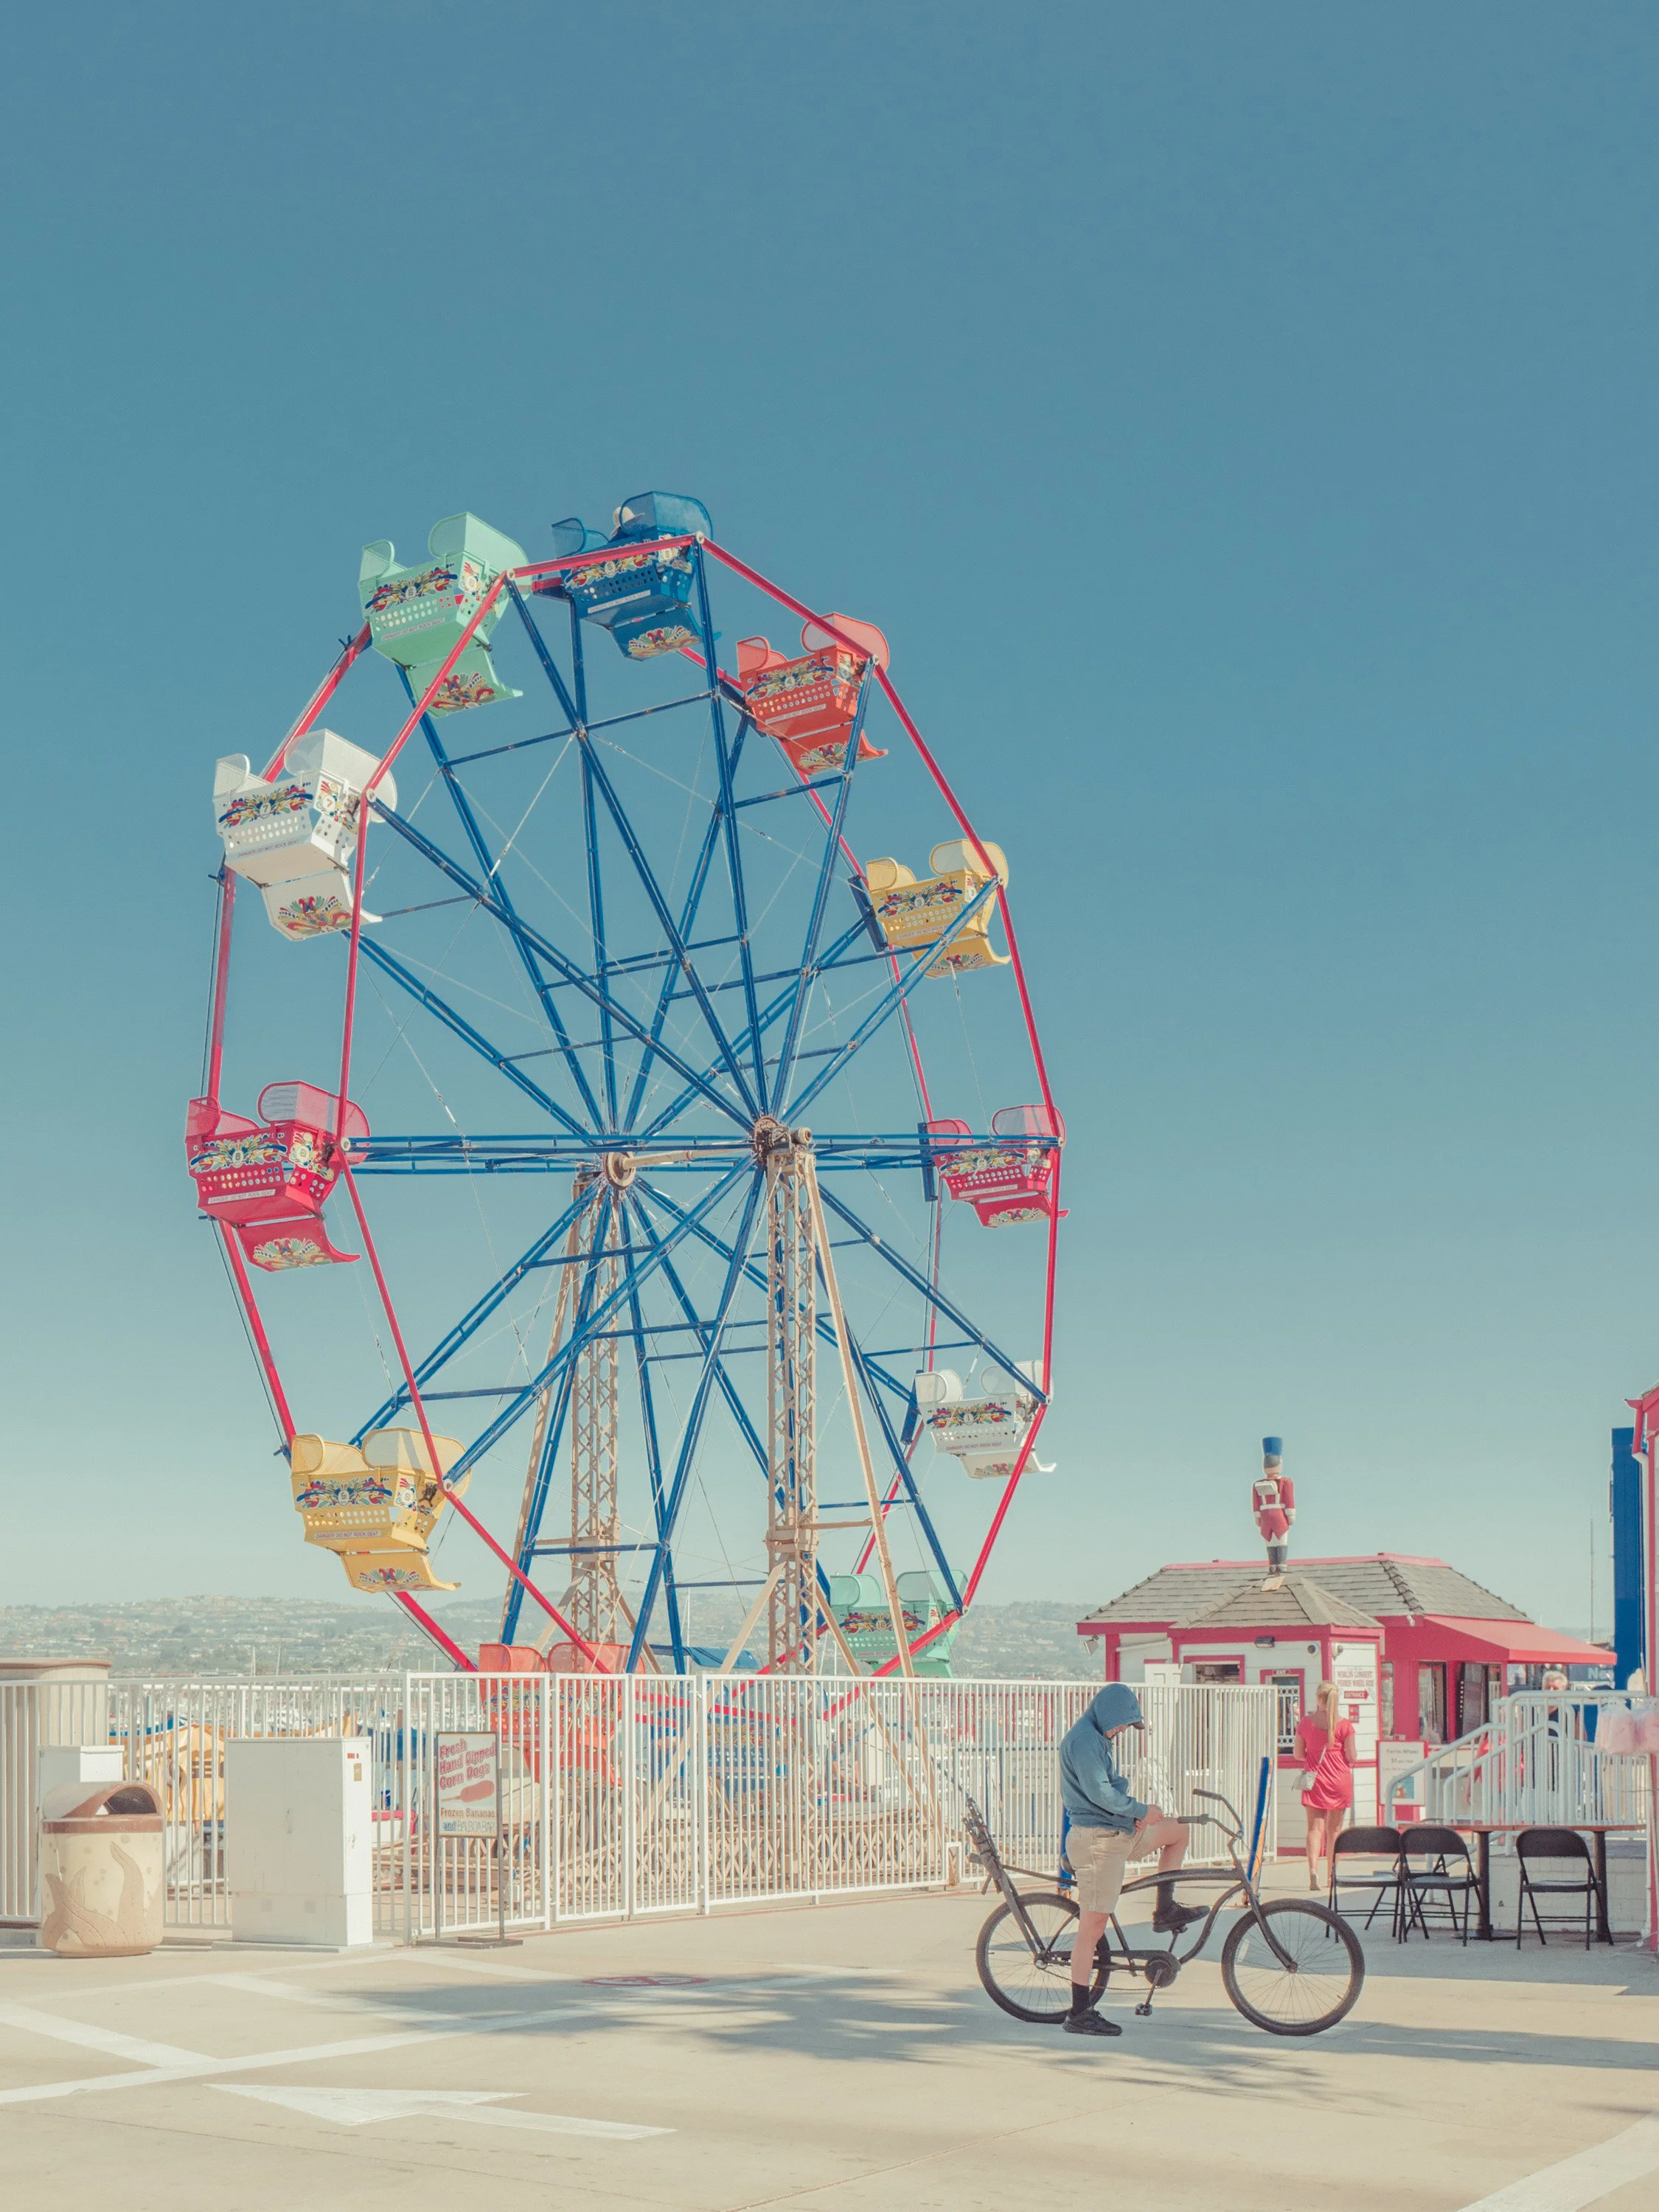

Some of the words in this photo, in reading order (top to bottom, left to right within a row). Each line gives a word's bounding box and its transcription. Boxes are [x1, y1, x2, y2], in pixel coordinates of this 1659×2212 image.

[439, 1738, 467, 1759] Fresh
[439, 1753, 464, 1775] Hand
[466, 1741, 496, 1765] Dipped
[439, 1773, 464, 1790] Corn
[466, 1763, 490, 1781] Dogs
[440, 1807, 464, 1818] Frozen
[466, 1807, 495, 1818] Bananas
[443, 1820, 456, 1829] and
